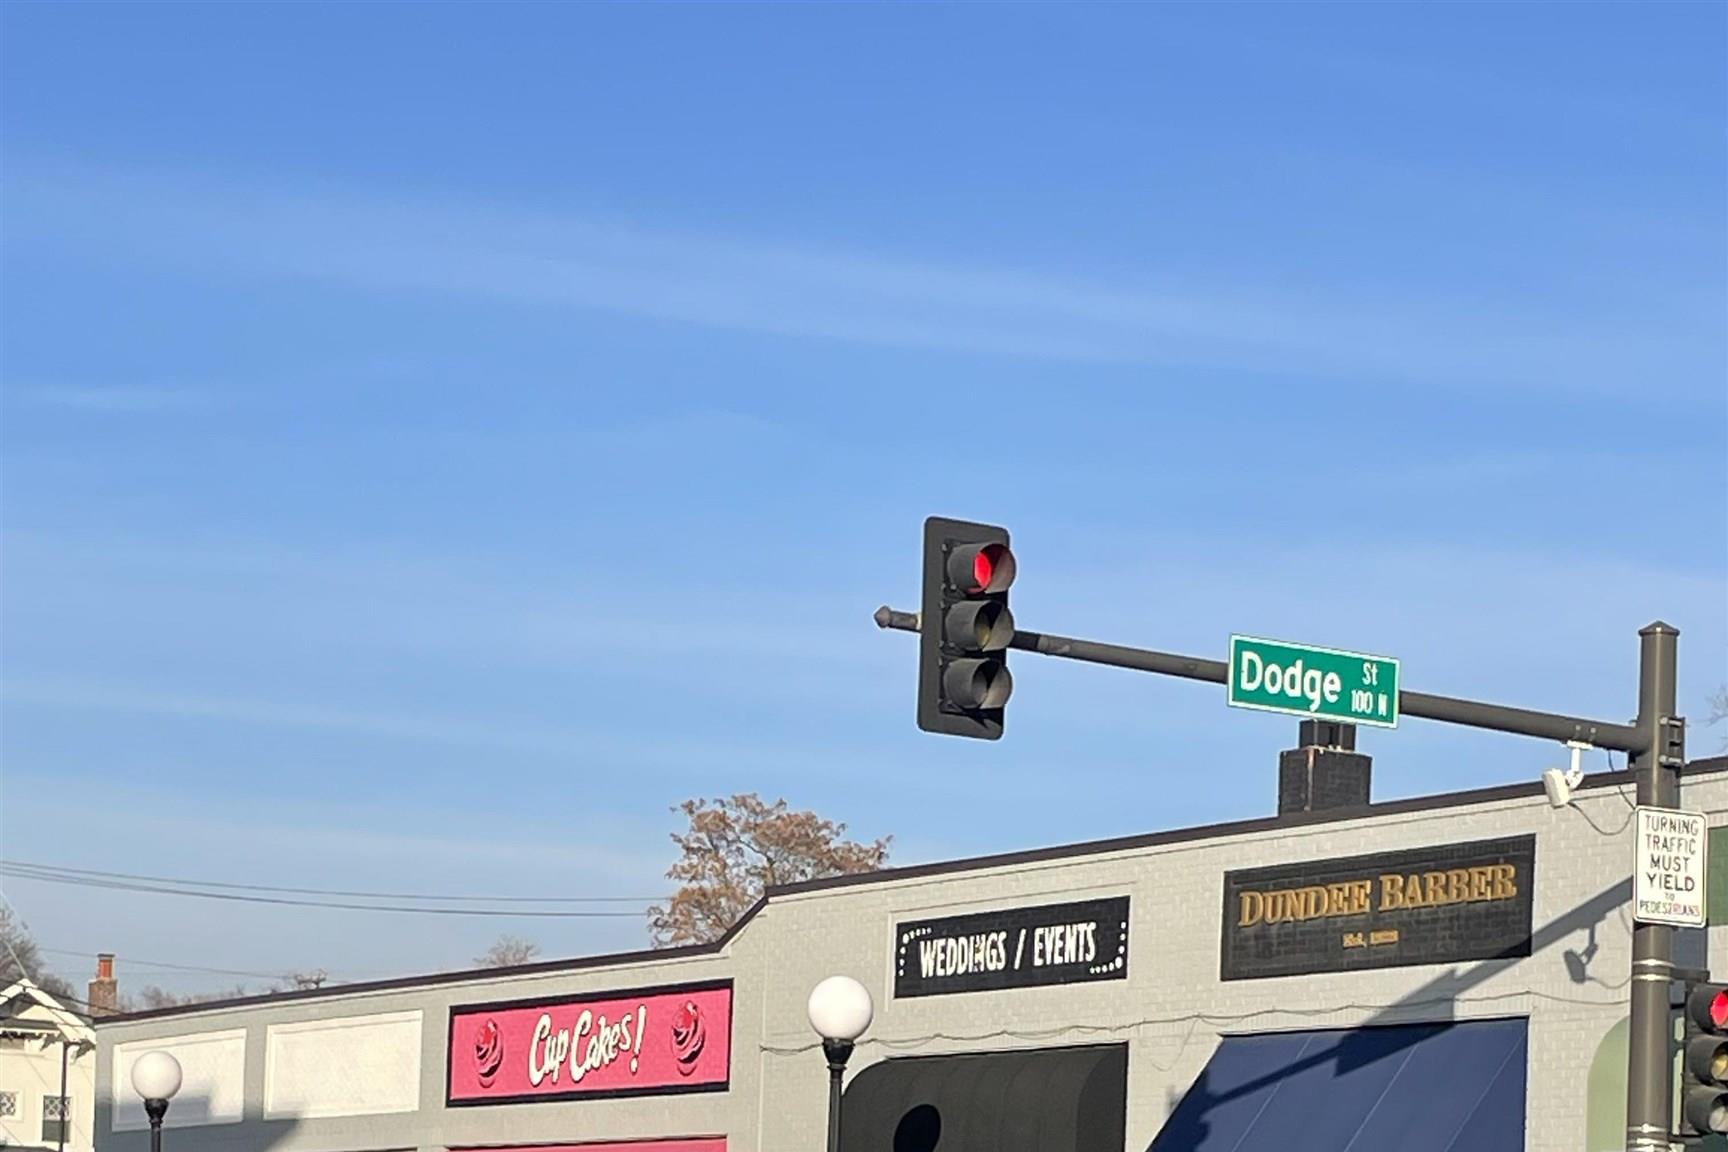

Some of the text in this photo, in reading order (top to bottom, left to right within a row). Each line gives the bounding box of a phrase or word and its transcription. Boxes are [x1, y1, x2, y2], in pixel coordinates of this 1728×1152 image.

[1241, 651, 1378, 712] Dodge St
[1351, 689, 1388, 717] 100 N
[1645, 815, 1699, 836] TURNING
[1646, 833, 1697, 855] TRAFFIC
[1650, 853, 1690, 872] MUST
[1237, 864, 1518, 928] DUNDEE BARBER
[1646, 872, 1695, 892] YIELD
[919, 921, 1097, 979] WEDDINGS / EVENTS
[528, 1004, 647, 1086] Cup Cakes!
